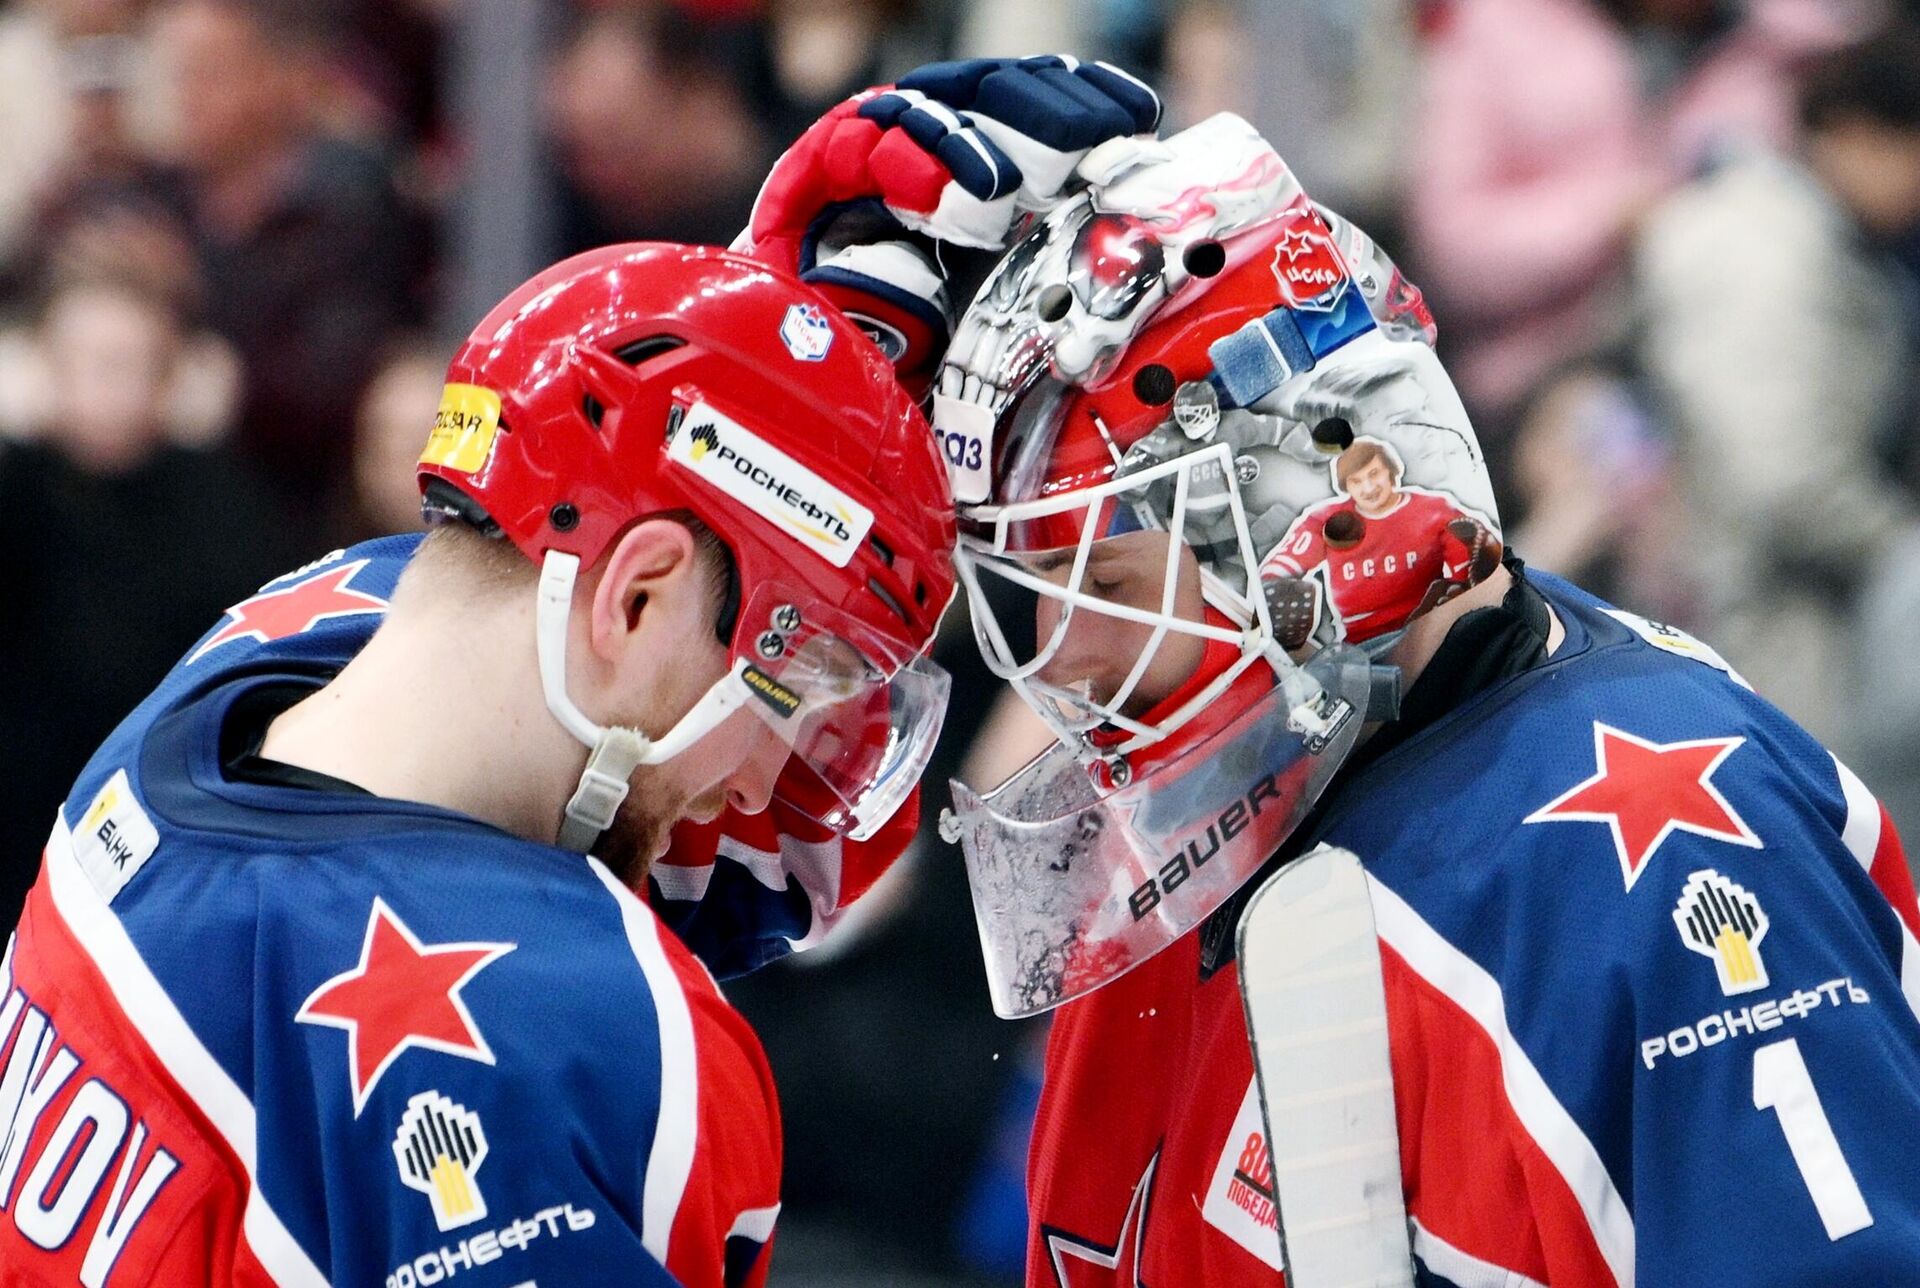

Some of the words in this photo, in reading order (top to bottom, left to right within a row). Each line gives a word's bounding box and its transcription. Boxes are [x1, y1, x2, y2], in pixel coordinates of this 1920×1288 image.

[1286, 265, 1337, 285] ЦСКА
[717, 445, 850, 541] РОСНЕФТЬ
[1641, 977, 1870, 1070] РОСНЕФТЬ
[1753, 1037, 1874, 1242] 1
[1227, 1178, 1279, 1231] ПОБЕДА
